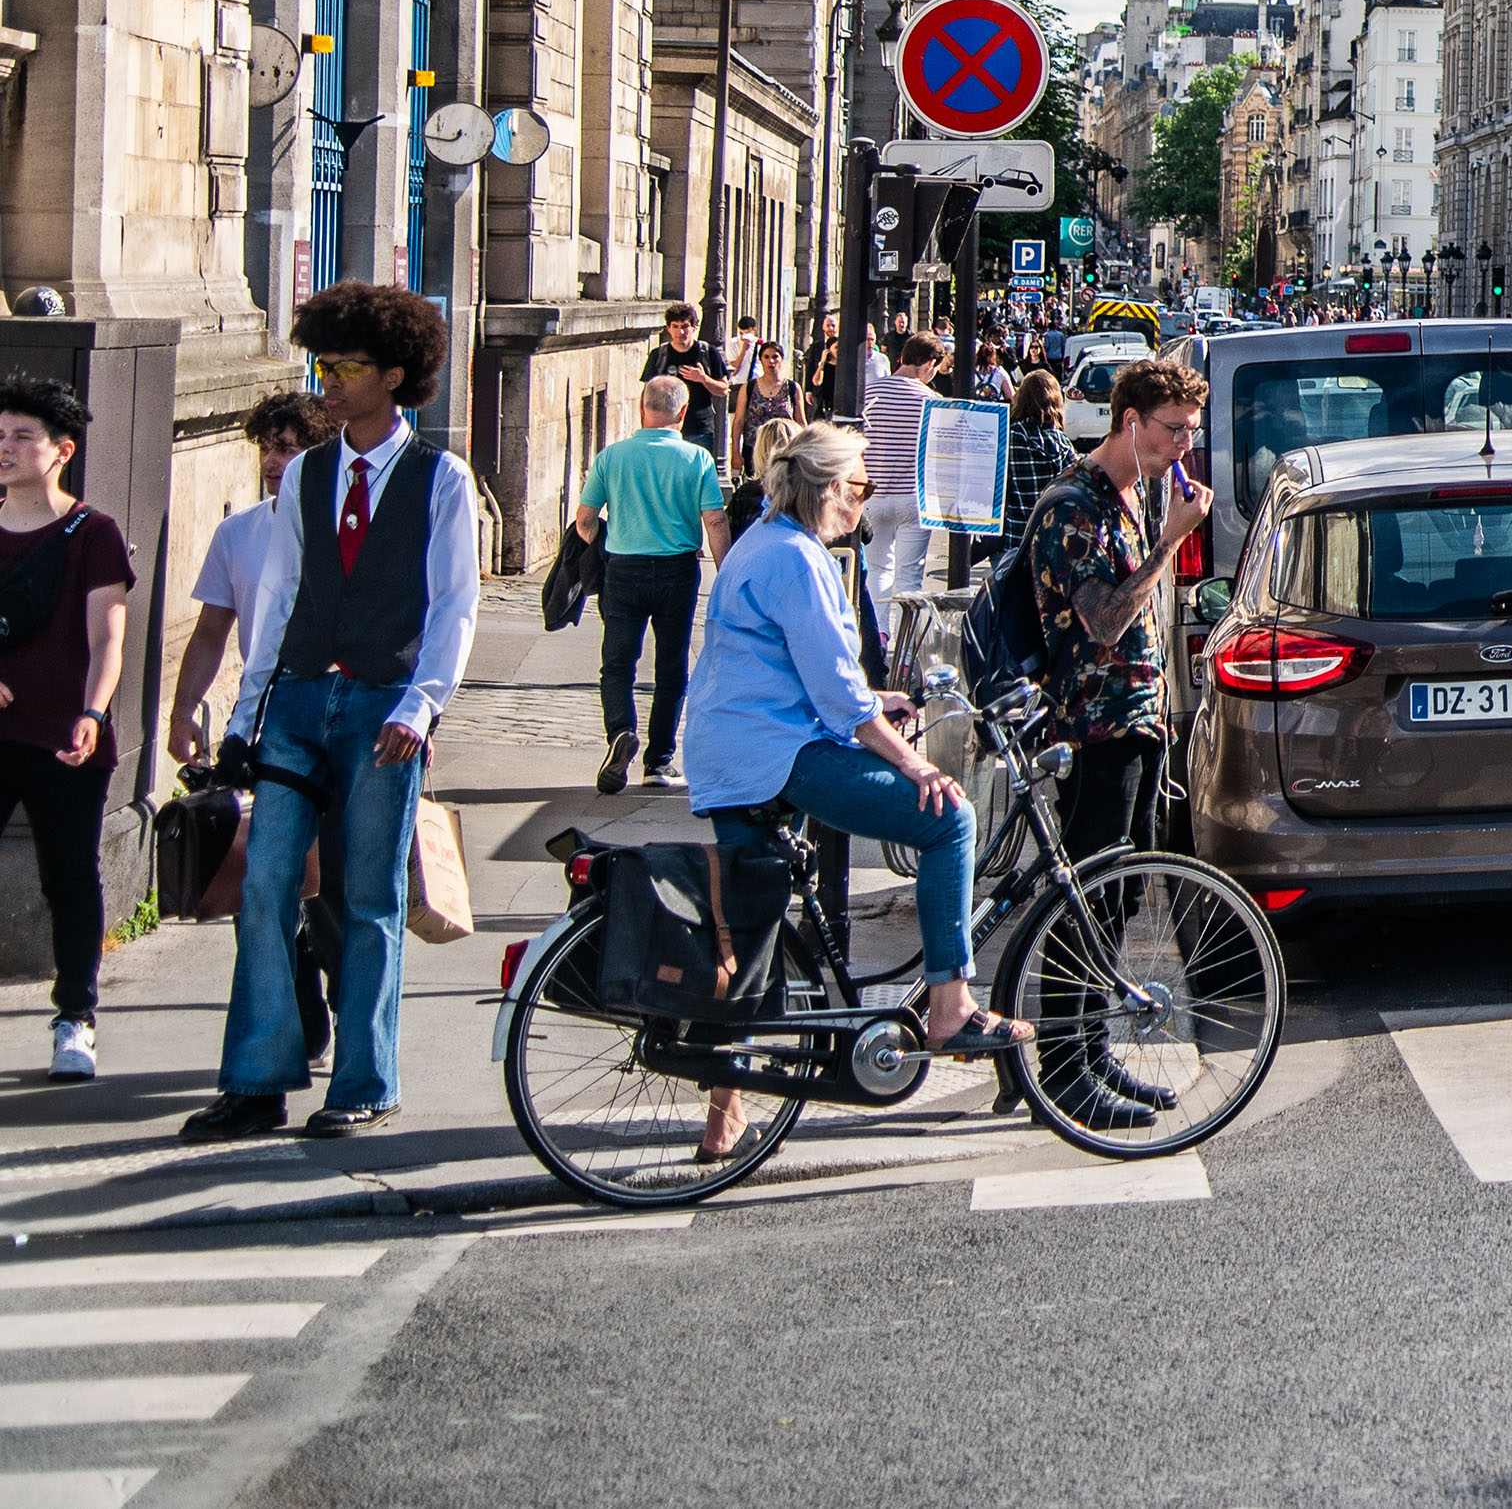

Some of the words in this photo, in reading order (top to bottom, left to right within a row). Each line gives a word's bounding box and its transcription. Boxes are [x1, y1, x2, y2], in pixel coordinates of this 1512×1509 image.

[1073, 224, 1094, 237] RER
[1021, 246, 1035, 267] P
[1488, 647, 1512, 659] Ford
